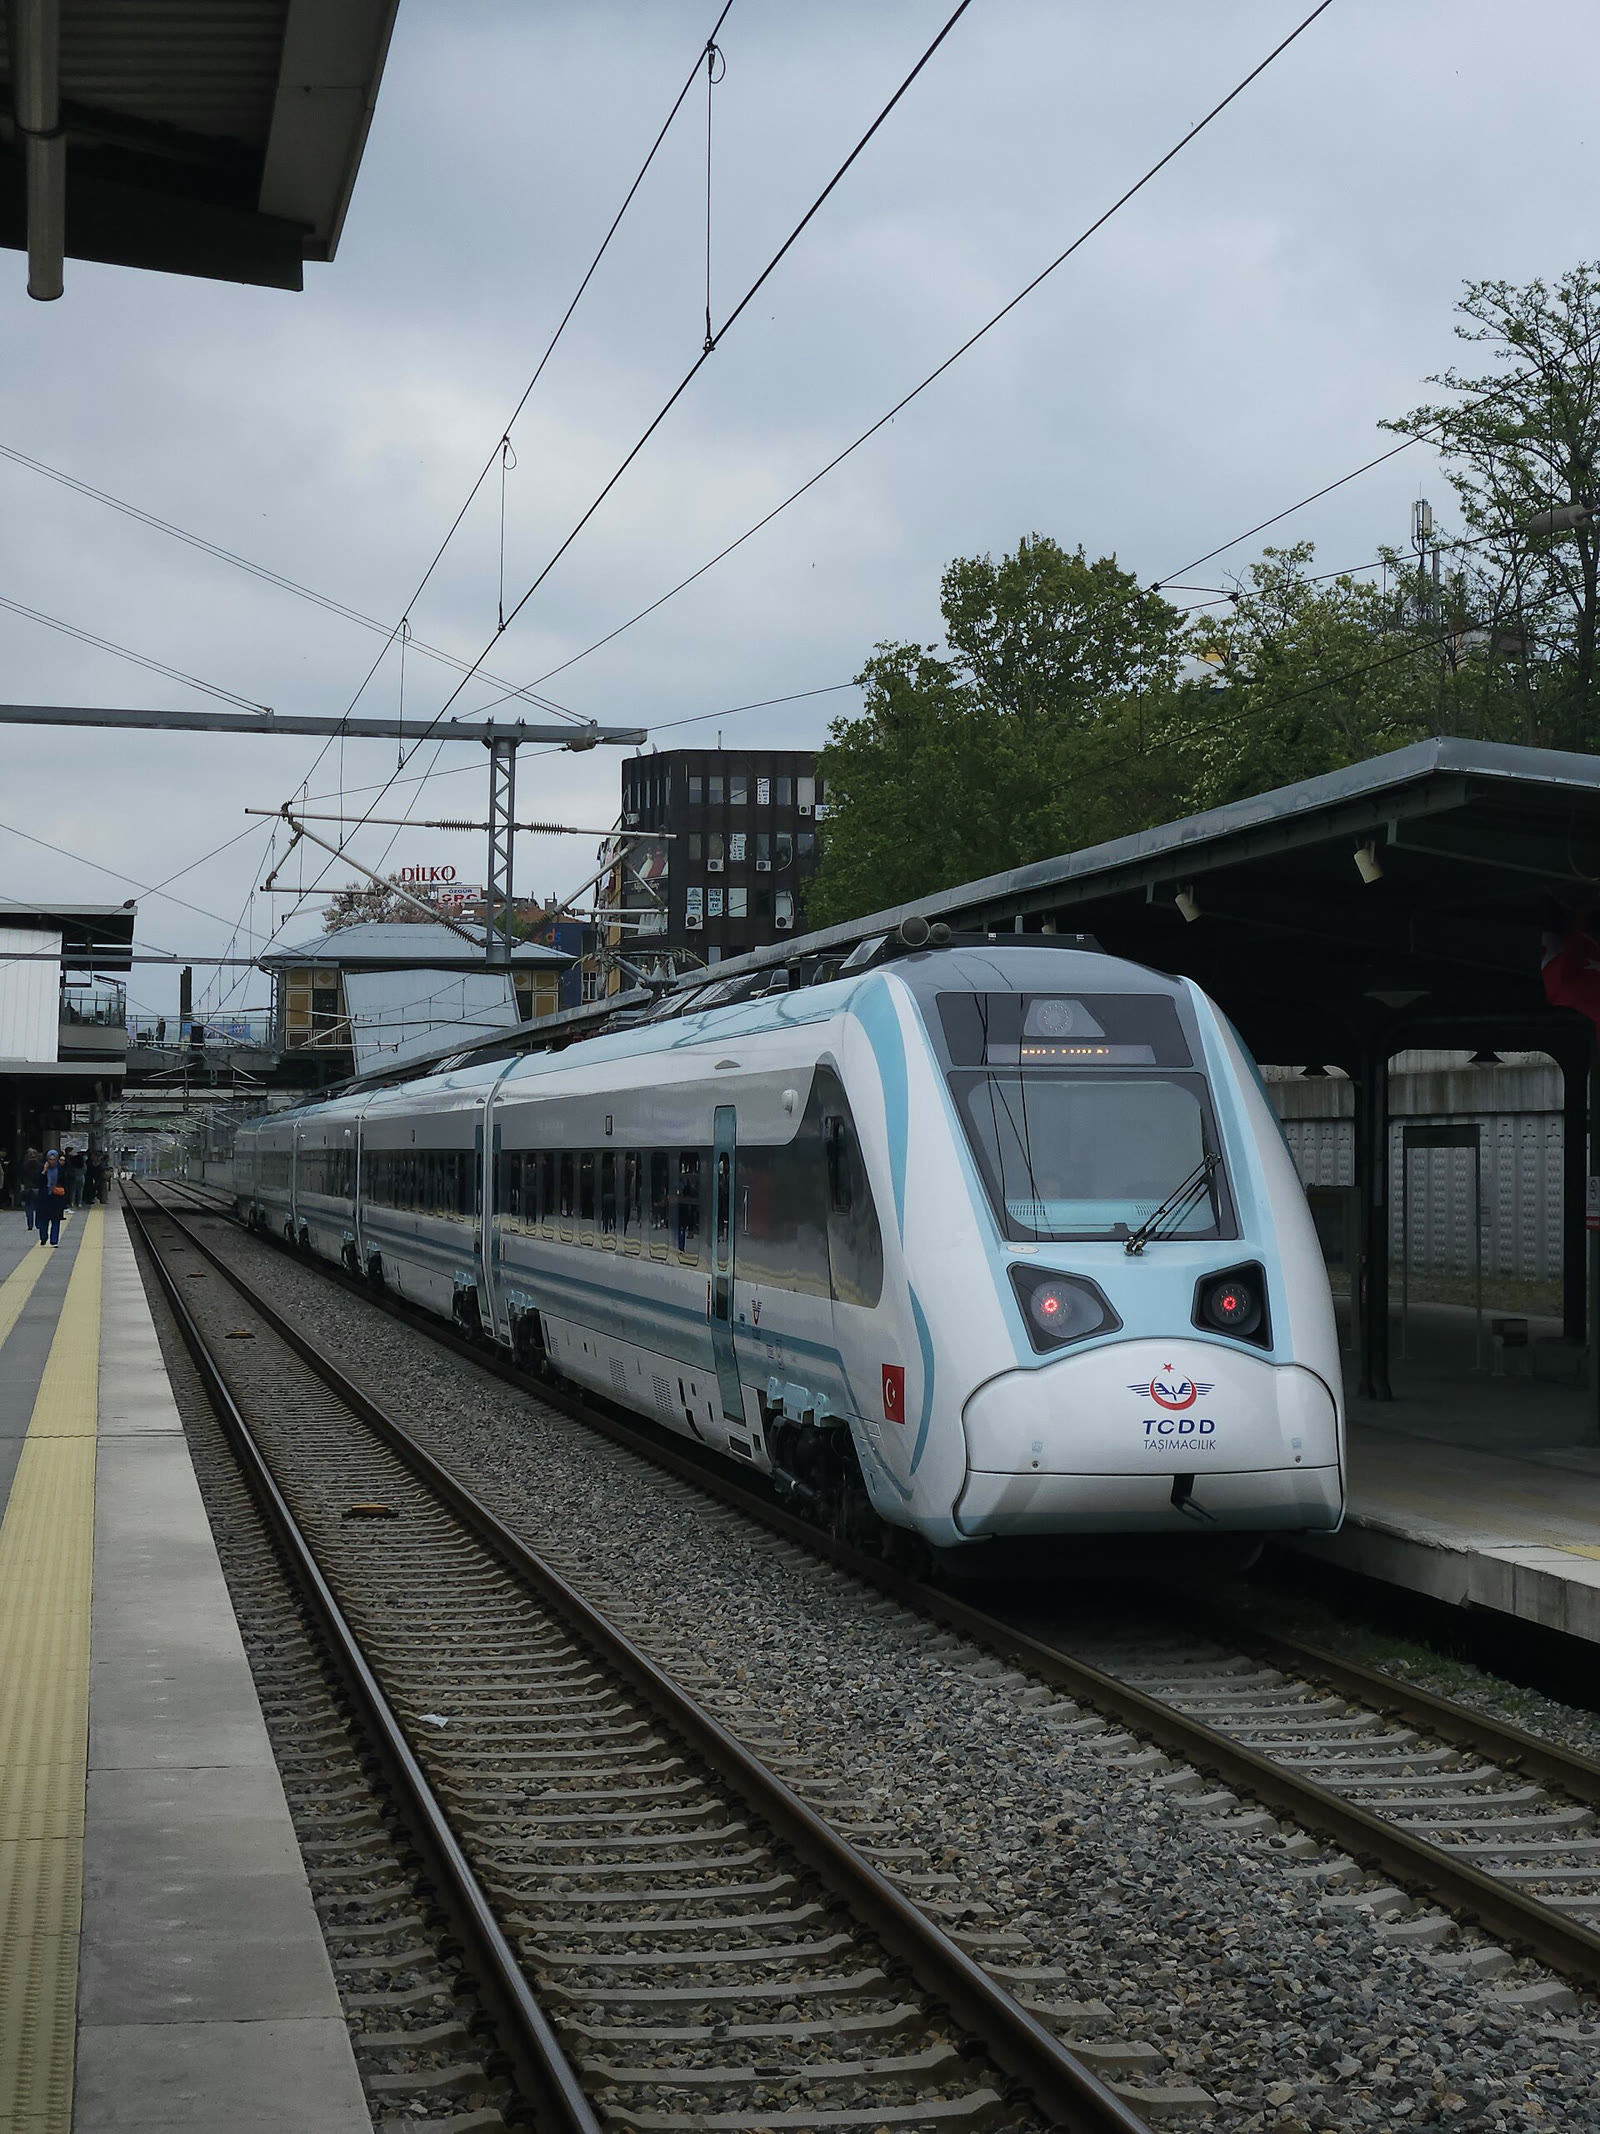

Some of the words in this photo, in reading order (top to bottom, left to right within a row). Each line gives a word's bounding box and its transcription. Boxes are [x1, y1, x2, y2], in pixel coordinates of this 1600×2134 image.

[401, 863, 456, 882] DİLKO
[1142, 1419, 1216, 1435] TCDD
[1143, 1439, 1217, 1452] TAŞIMACILIK
